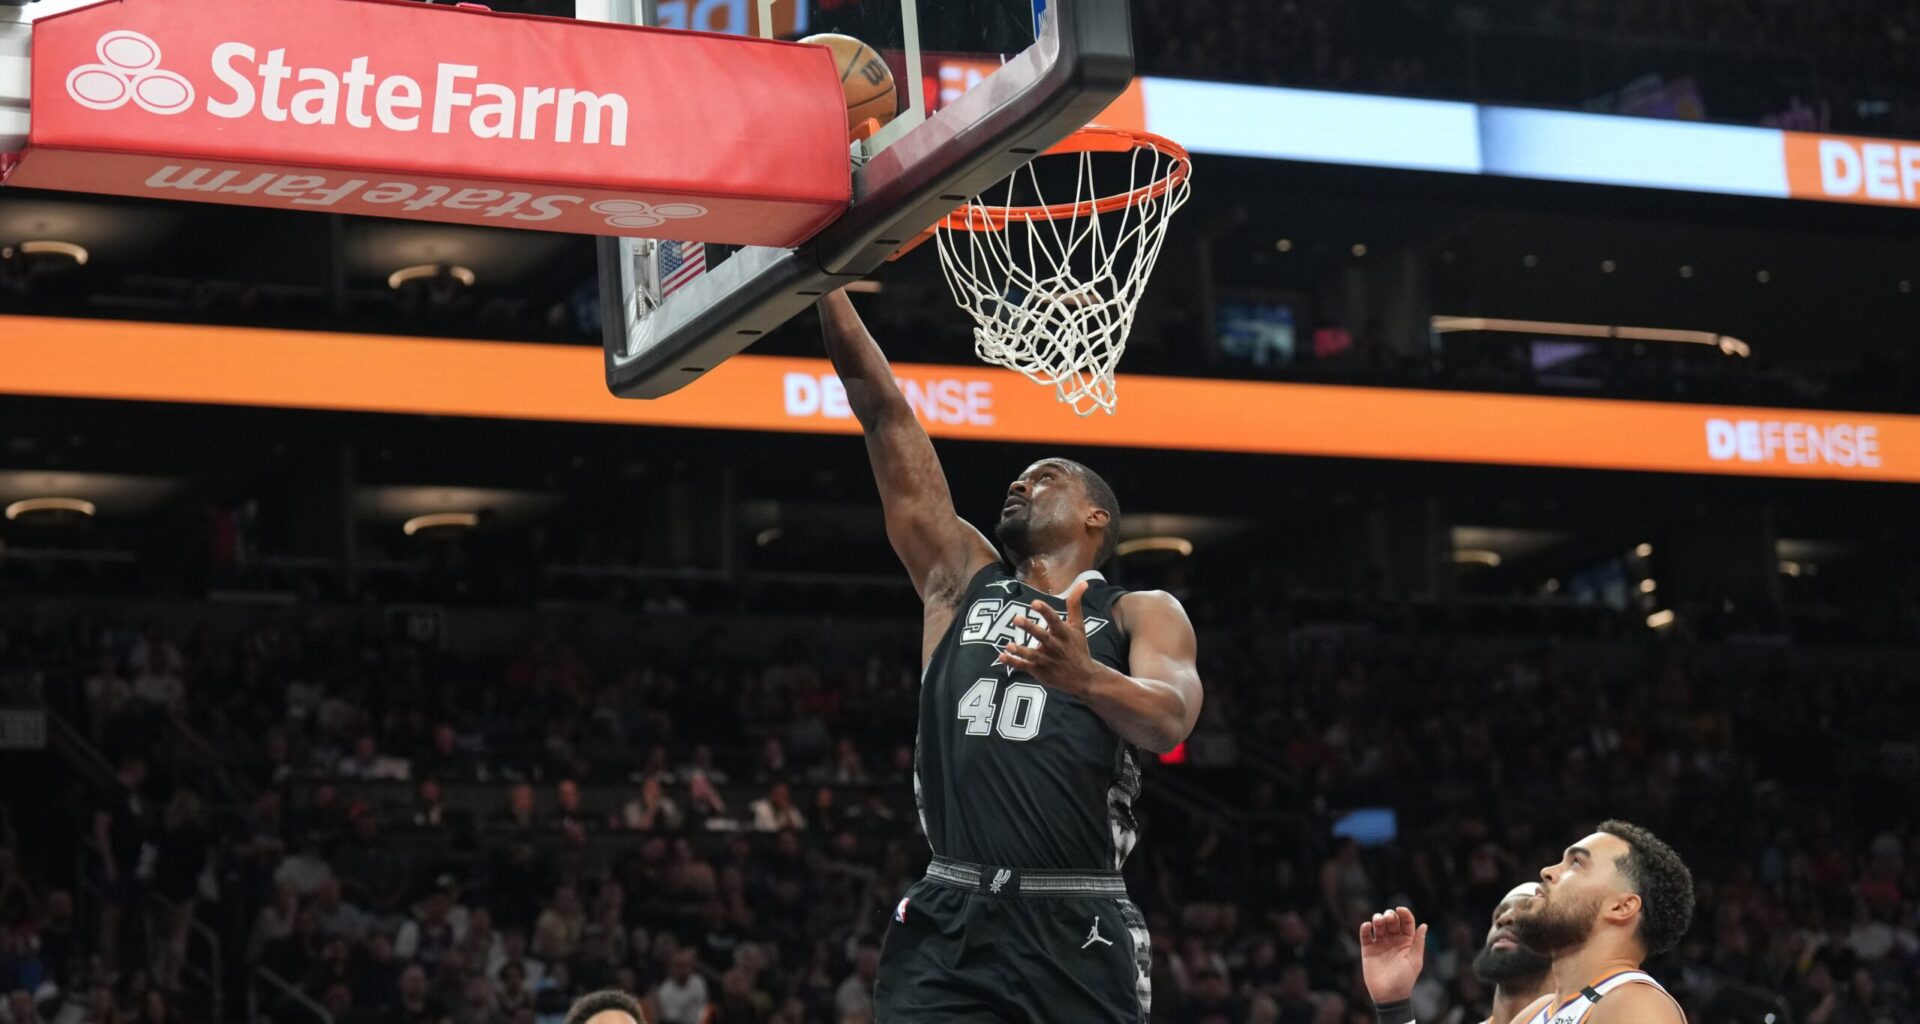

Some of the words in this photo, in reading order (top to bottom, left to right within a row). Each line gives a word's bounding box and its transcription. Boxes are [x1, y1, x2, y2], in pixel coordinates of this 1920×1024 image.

[784, 371, 994, 425] DENSE
[1706, 418, 1882, 468] DEFENSE
[958, 678, 1048, 741] 40
